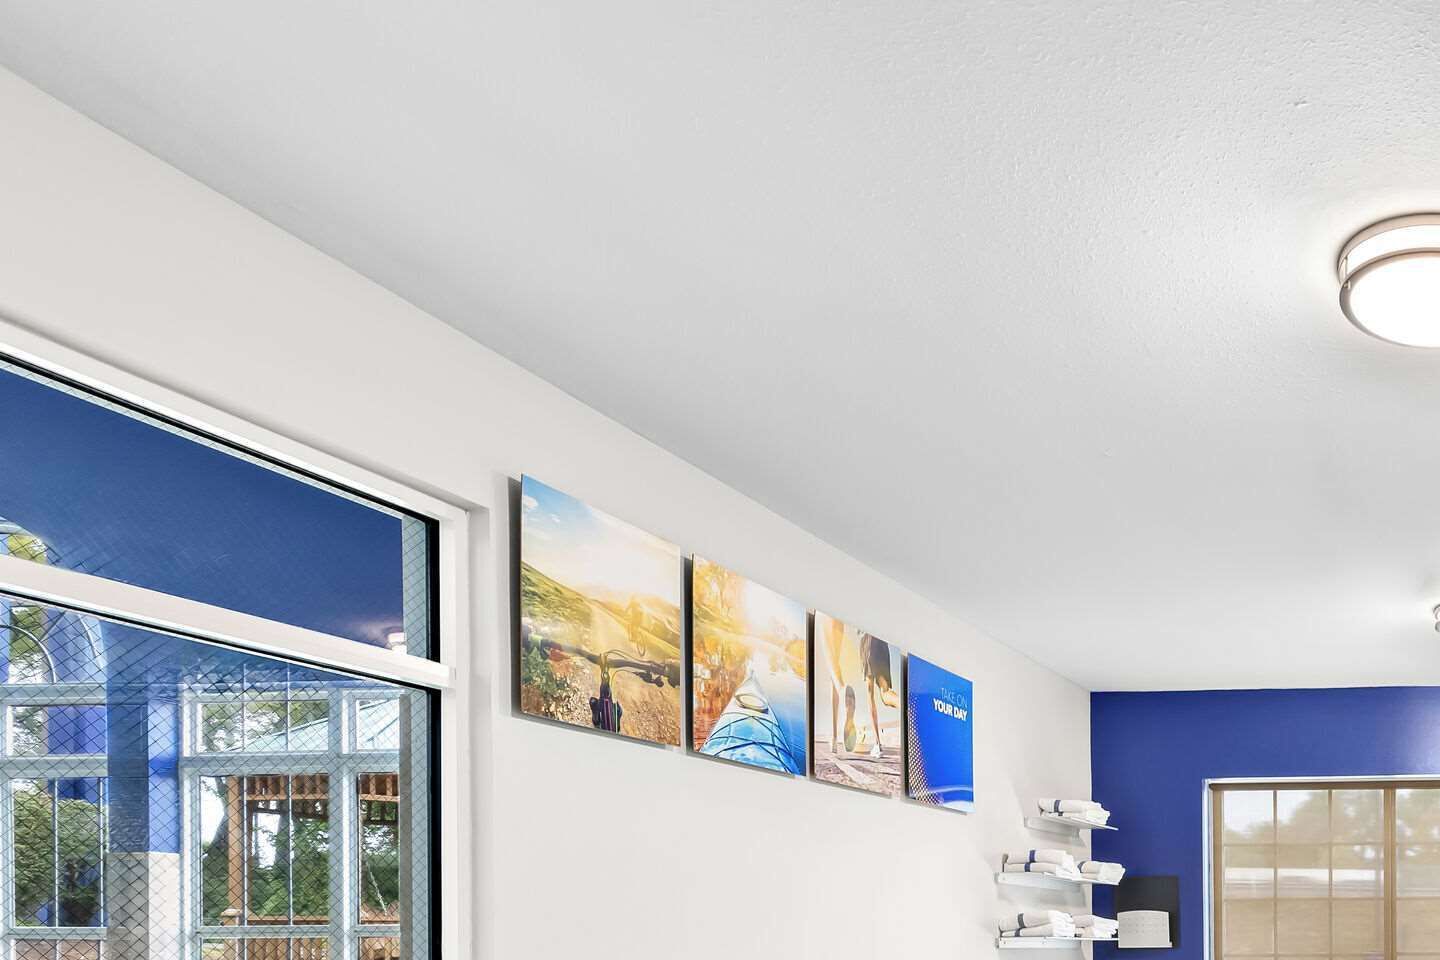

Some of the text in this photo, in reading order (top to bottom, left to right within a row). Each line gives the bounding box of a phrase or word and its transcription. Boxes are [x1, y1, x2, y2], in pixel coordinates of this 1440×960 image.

[940, 688, 968, 708] TAKE ON
[933, 698, 968, 721] YOUR DAY
